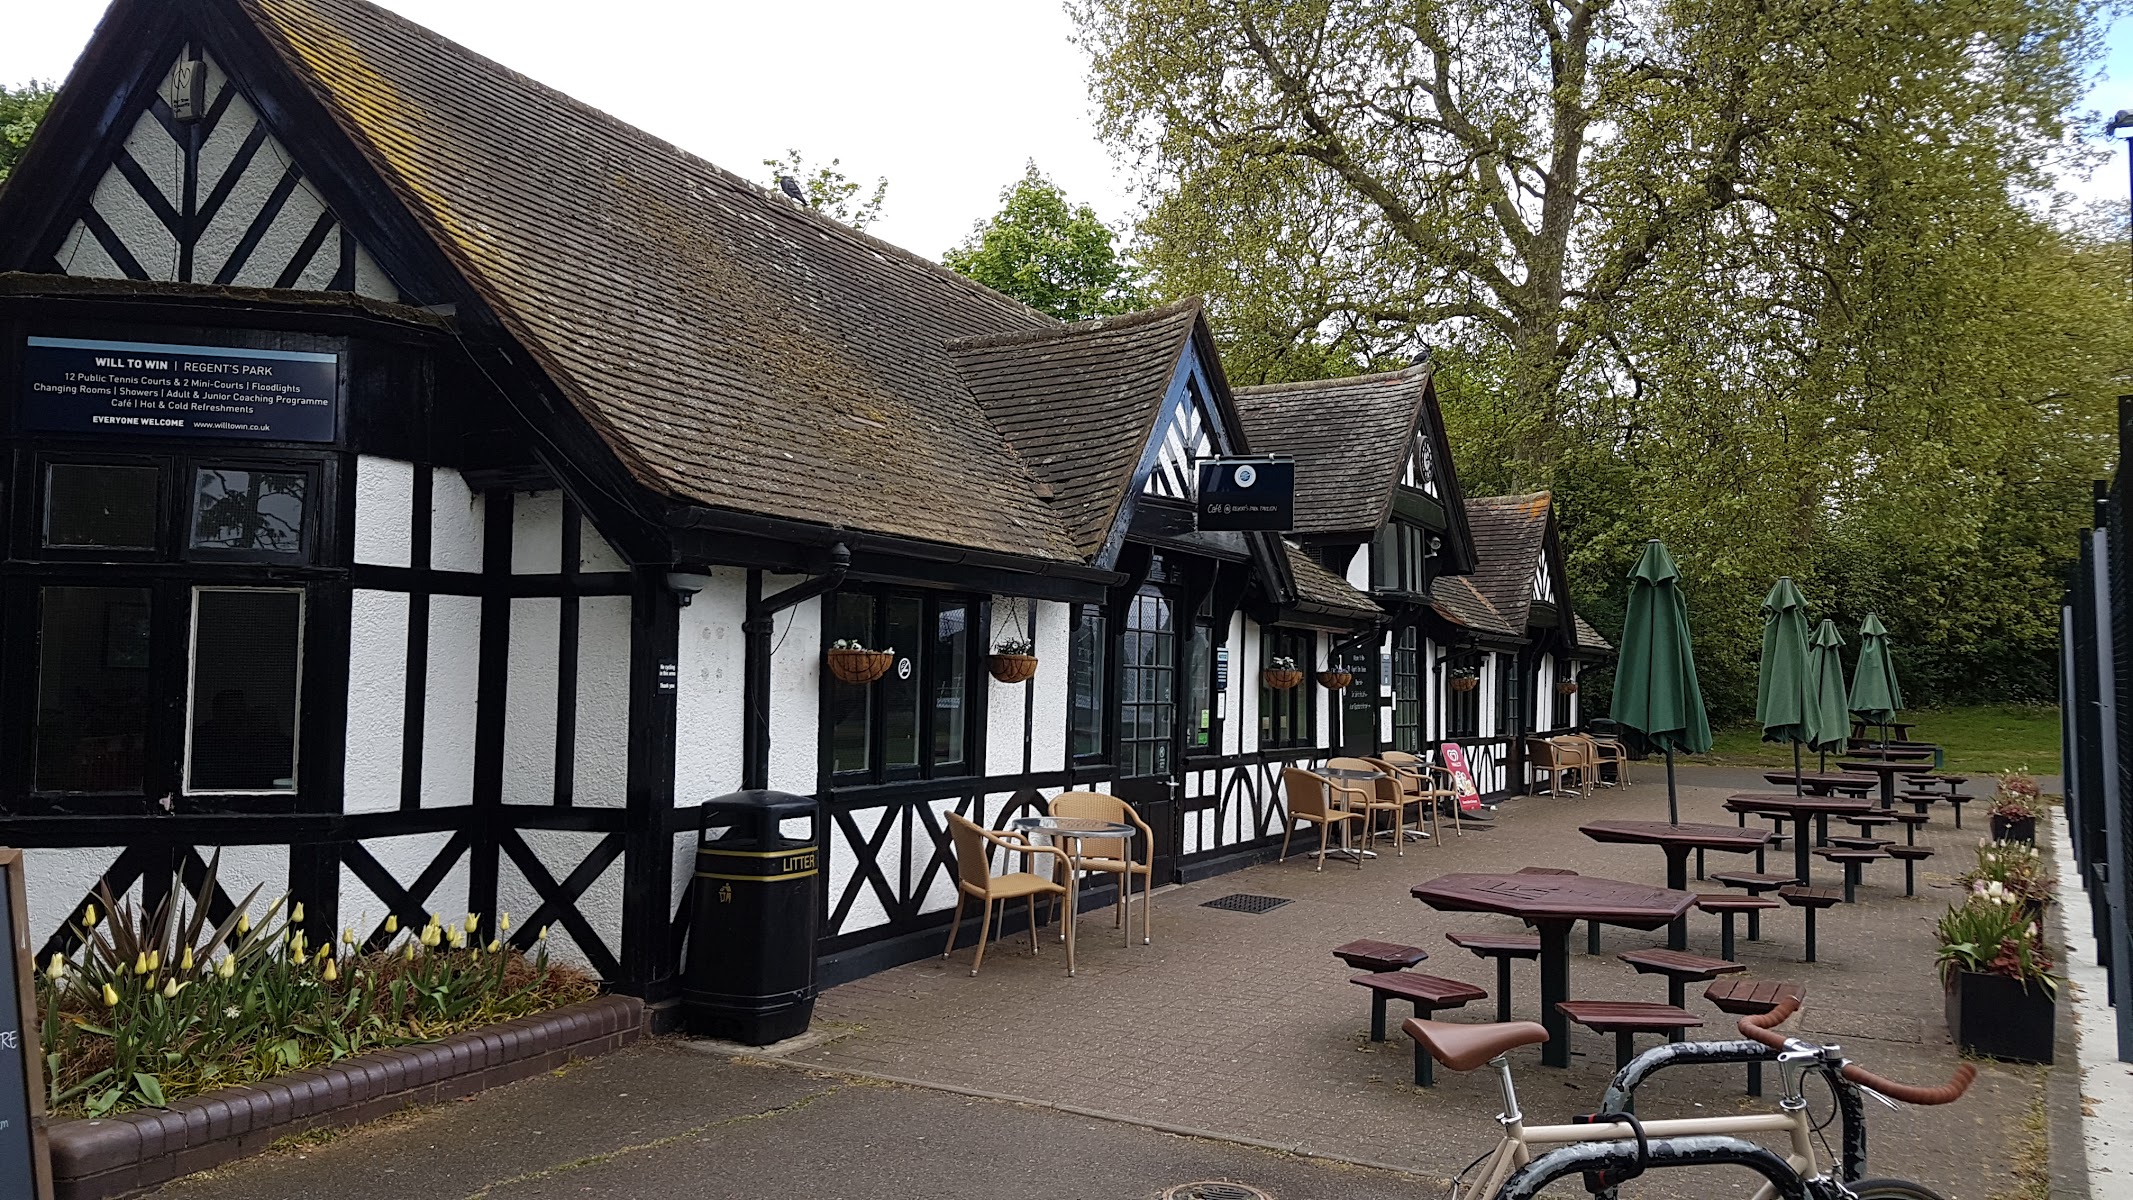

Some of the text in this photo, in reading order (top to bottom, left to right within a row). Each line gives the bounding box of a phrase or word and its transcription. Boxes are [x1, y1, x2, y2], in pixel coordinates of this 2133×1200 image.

[95, 357, 273, 376] WILL TO WIN REGENT'S PARK
[65, 372, 301, 393] 12 Public Tennis Courts & 2 Mini-Courts Floodlights
[33, 383, 329, 406] Changing Rooms Showers Adult & Junior Coaching Programme
[111, 398, 254, 414] Café Hot & Cold Refreshments
[92, 415, 270, 432] EVERYONE WELCOME www.willtowin.co.uk
[783, 854, 816, 872] LITTER
